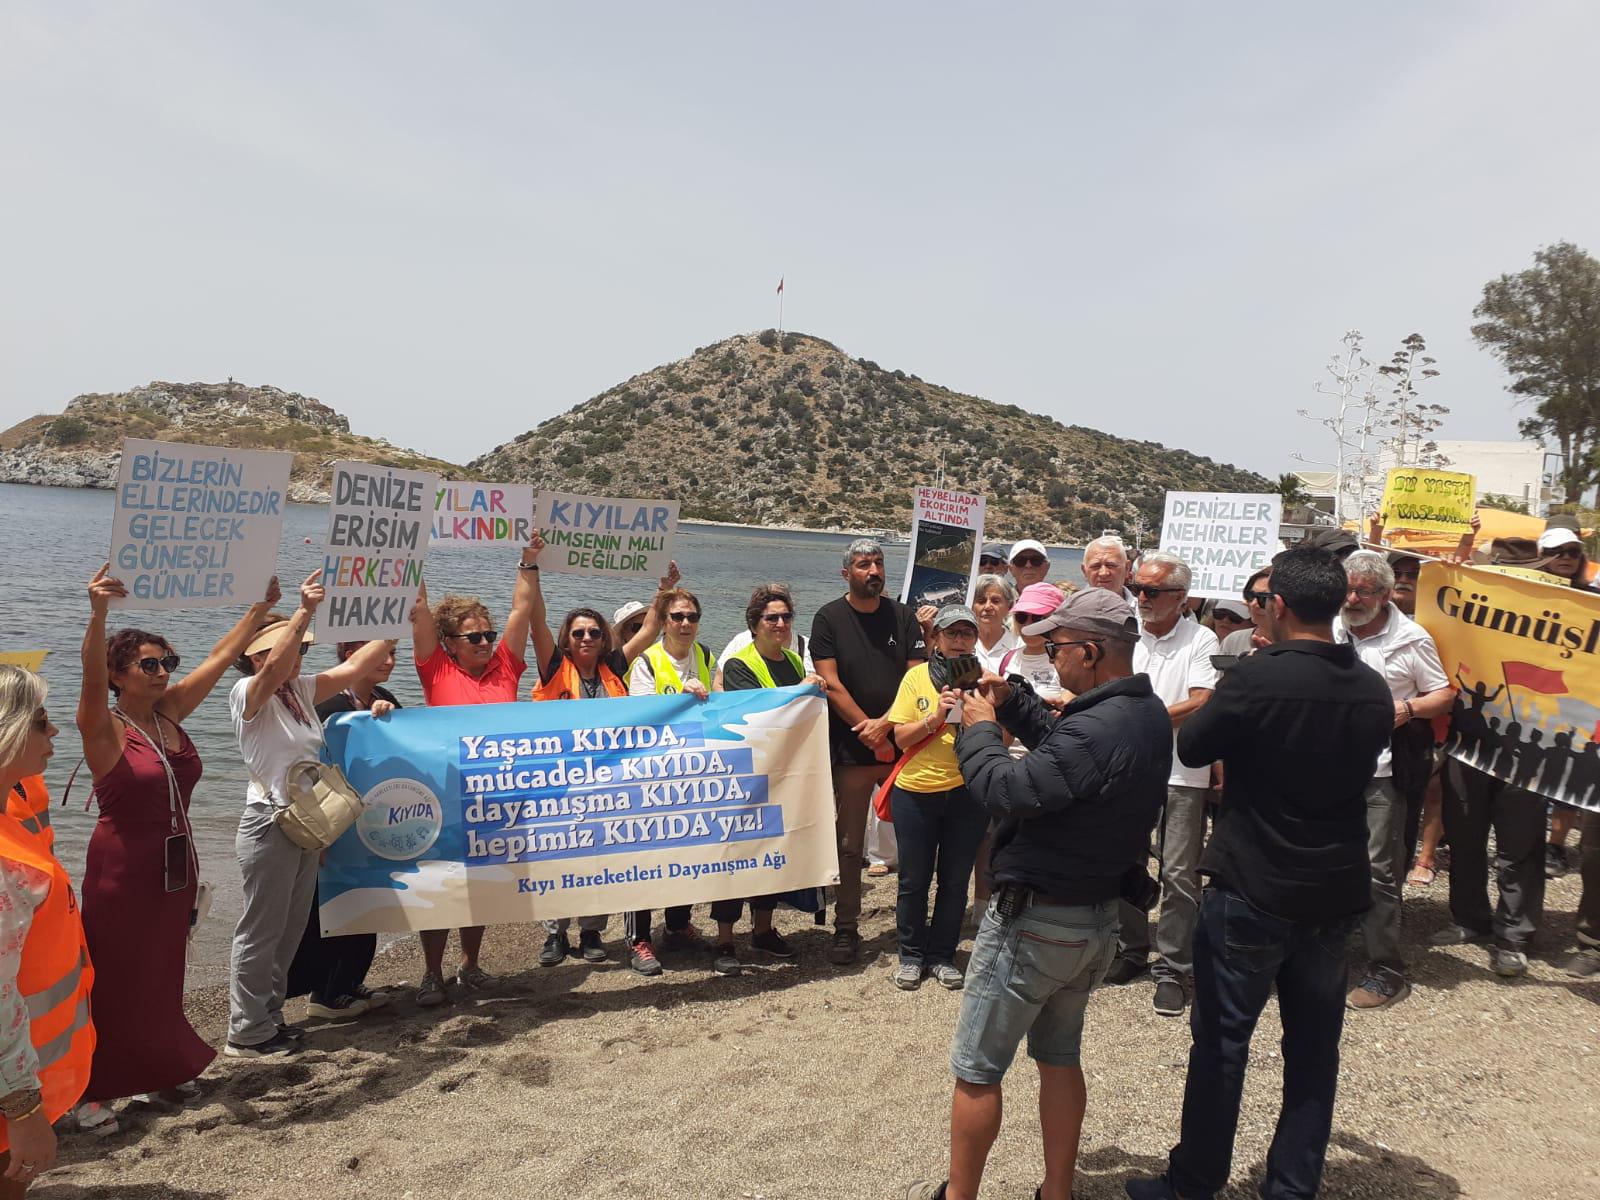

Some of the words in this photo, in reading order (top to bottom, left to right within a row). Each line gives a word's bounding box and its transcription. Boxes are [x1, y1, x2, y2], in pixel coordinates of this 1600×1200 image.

[132, 450, 243, 487] BİZLERİN
[121, 483, 281, 516] ELLERİNDEDİR
[336, 471, 424, 512] DENİZE
[920, 499, 969, 516] EKOKIRIM
[549, 499, 670, 533] KIYILAR
[924, 510, 970, 527] ALTINDA
[1172, 496, 1272, 522] DENİZLER
[129, 513, 245, 541] GELECEK
[330, 510, 420, 554] ERİŞİM
[539, 526, 622, 551] KİMSENİN
[628, 535, 665, 552] MALI
[1166, 520, 1268, 546] NEHİRLER
[118, 540, 230, 575] GÜNEŞLİ
[322, 552, 424, 588] HERKESİN
[567, 549, 649, 572] DEĞİLDİR
[1166, 545, 1267, 570] SERMAYE
[133, 570, 234, 600] GÜNLER
[328, 596, 406, 628] HAKKI
[461, 735, 563, 765] Yaşam
[571, 725, 687, 753] KIYIDA,
[465, 757, 613, 794] mücadele
[620, 750, 735, 782] KIYIDA,
[388, 803, 434, 826] KIYIDA
[465, 790, 632, 829] dayanışma
[640, 777, 752, 808] KIYIDA,
[467, 824, 594, 863] hepimiz
[518, 878, 555, 896] Kıyı
[561, 864, 662, 889] Hareketleri
[668, 856, 757, 876] Dayanışma
[762, 850, 787, 870] Ağı
